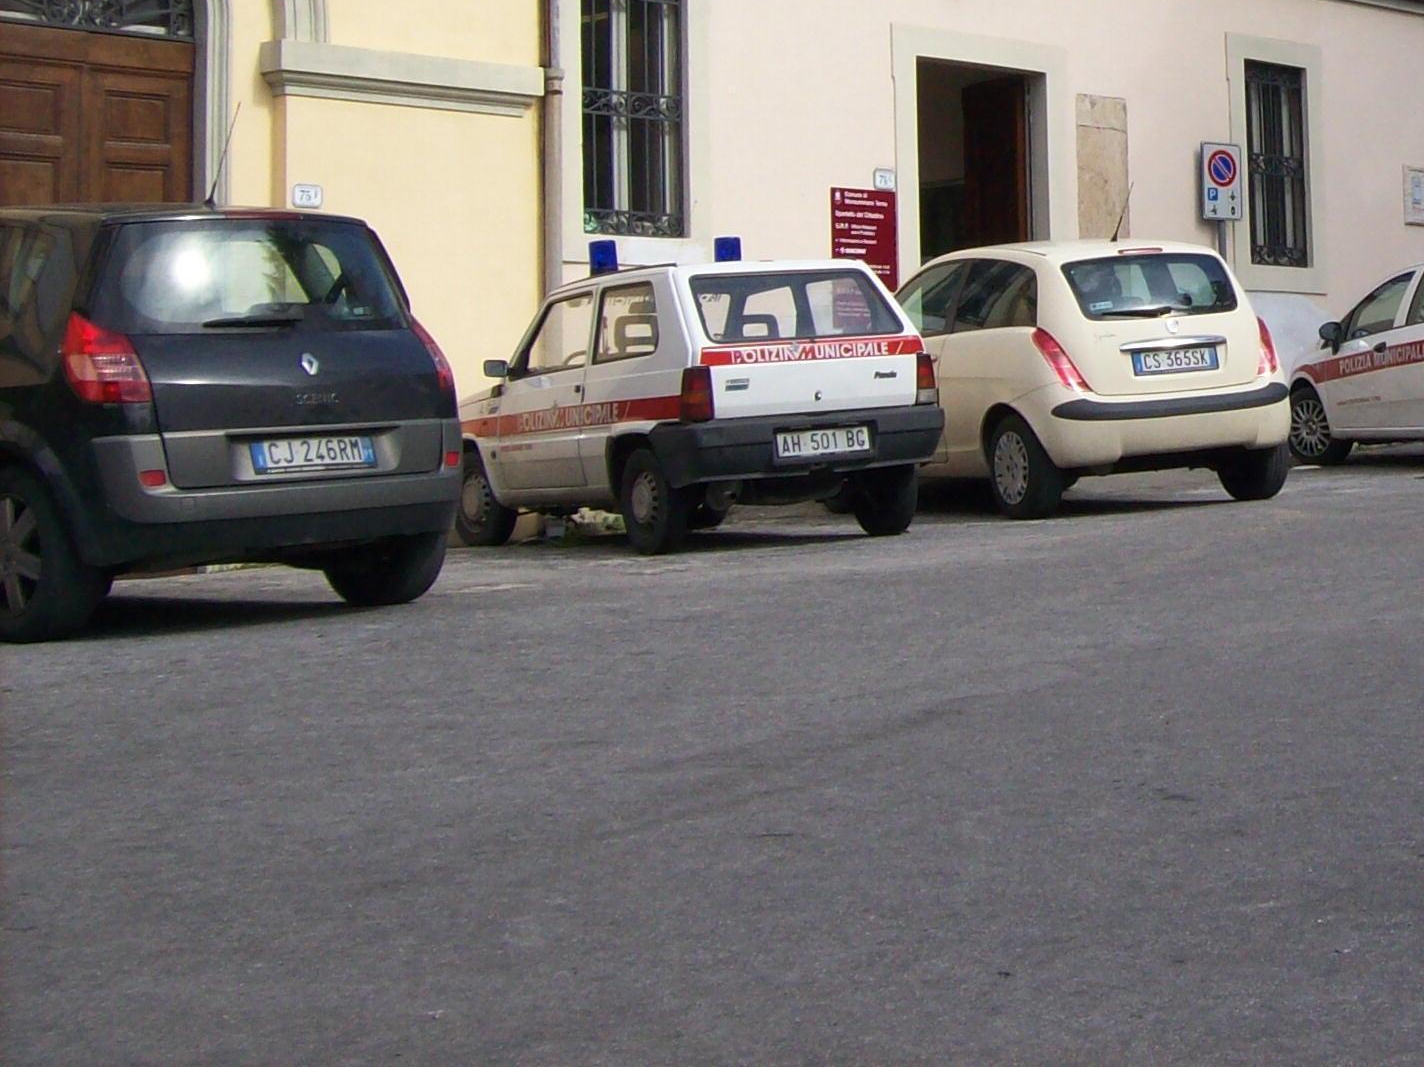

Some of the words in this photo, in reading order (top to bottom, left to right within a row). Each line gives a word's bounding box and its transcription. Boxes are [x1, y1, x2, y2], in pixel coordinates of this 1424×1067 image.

[1209, 188, 1217, 201] P
[1143, 353, 1161, 370] CS
[1166, 349, 1208, 369] 365SK
[1339, 358, 1373, 375] POLIZIA
[268, 442, 295, 465] CJ
[300, 437, 363, 463] 246RM
[782, 433, 801, 455] AH
[811, 432, 838, 451] 501
